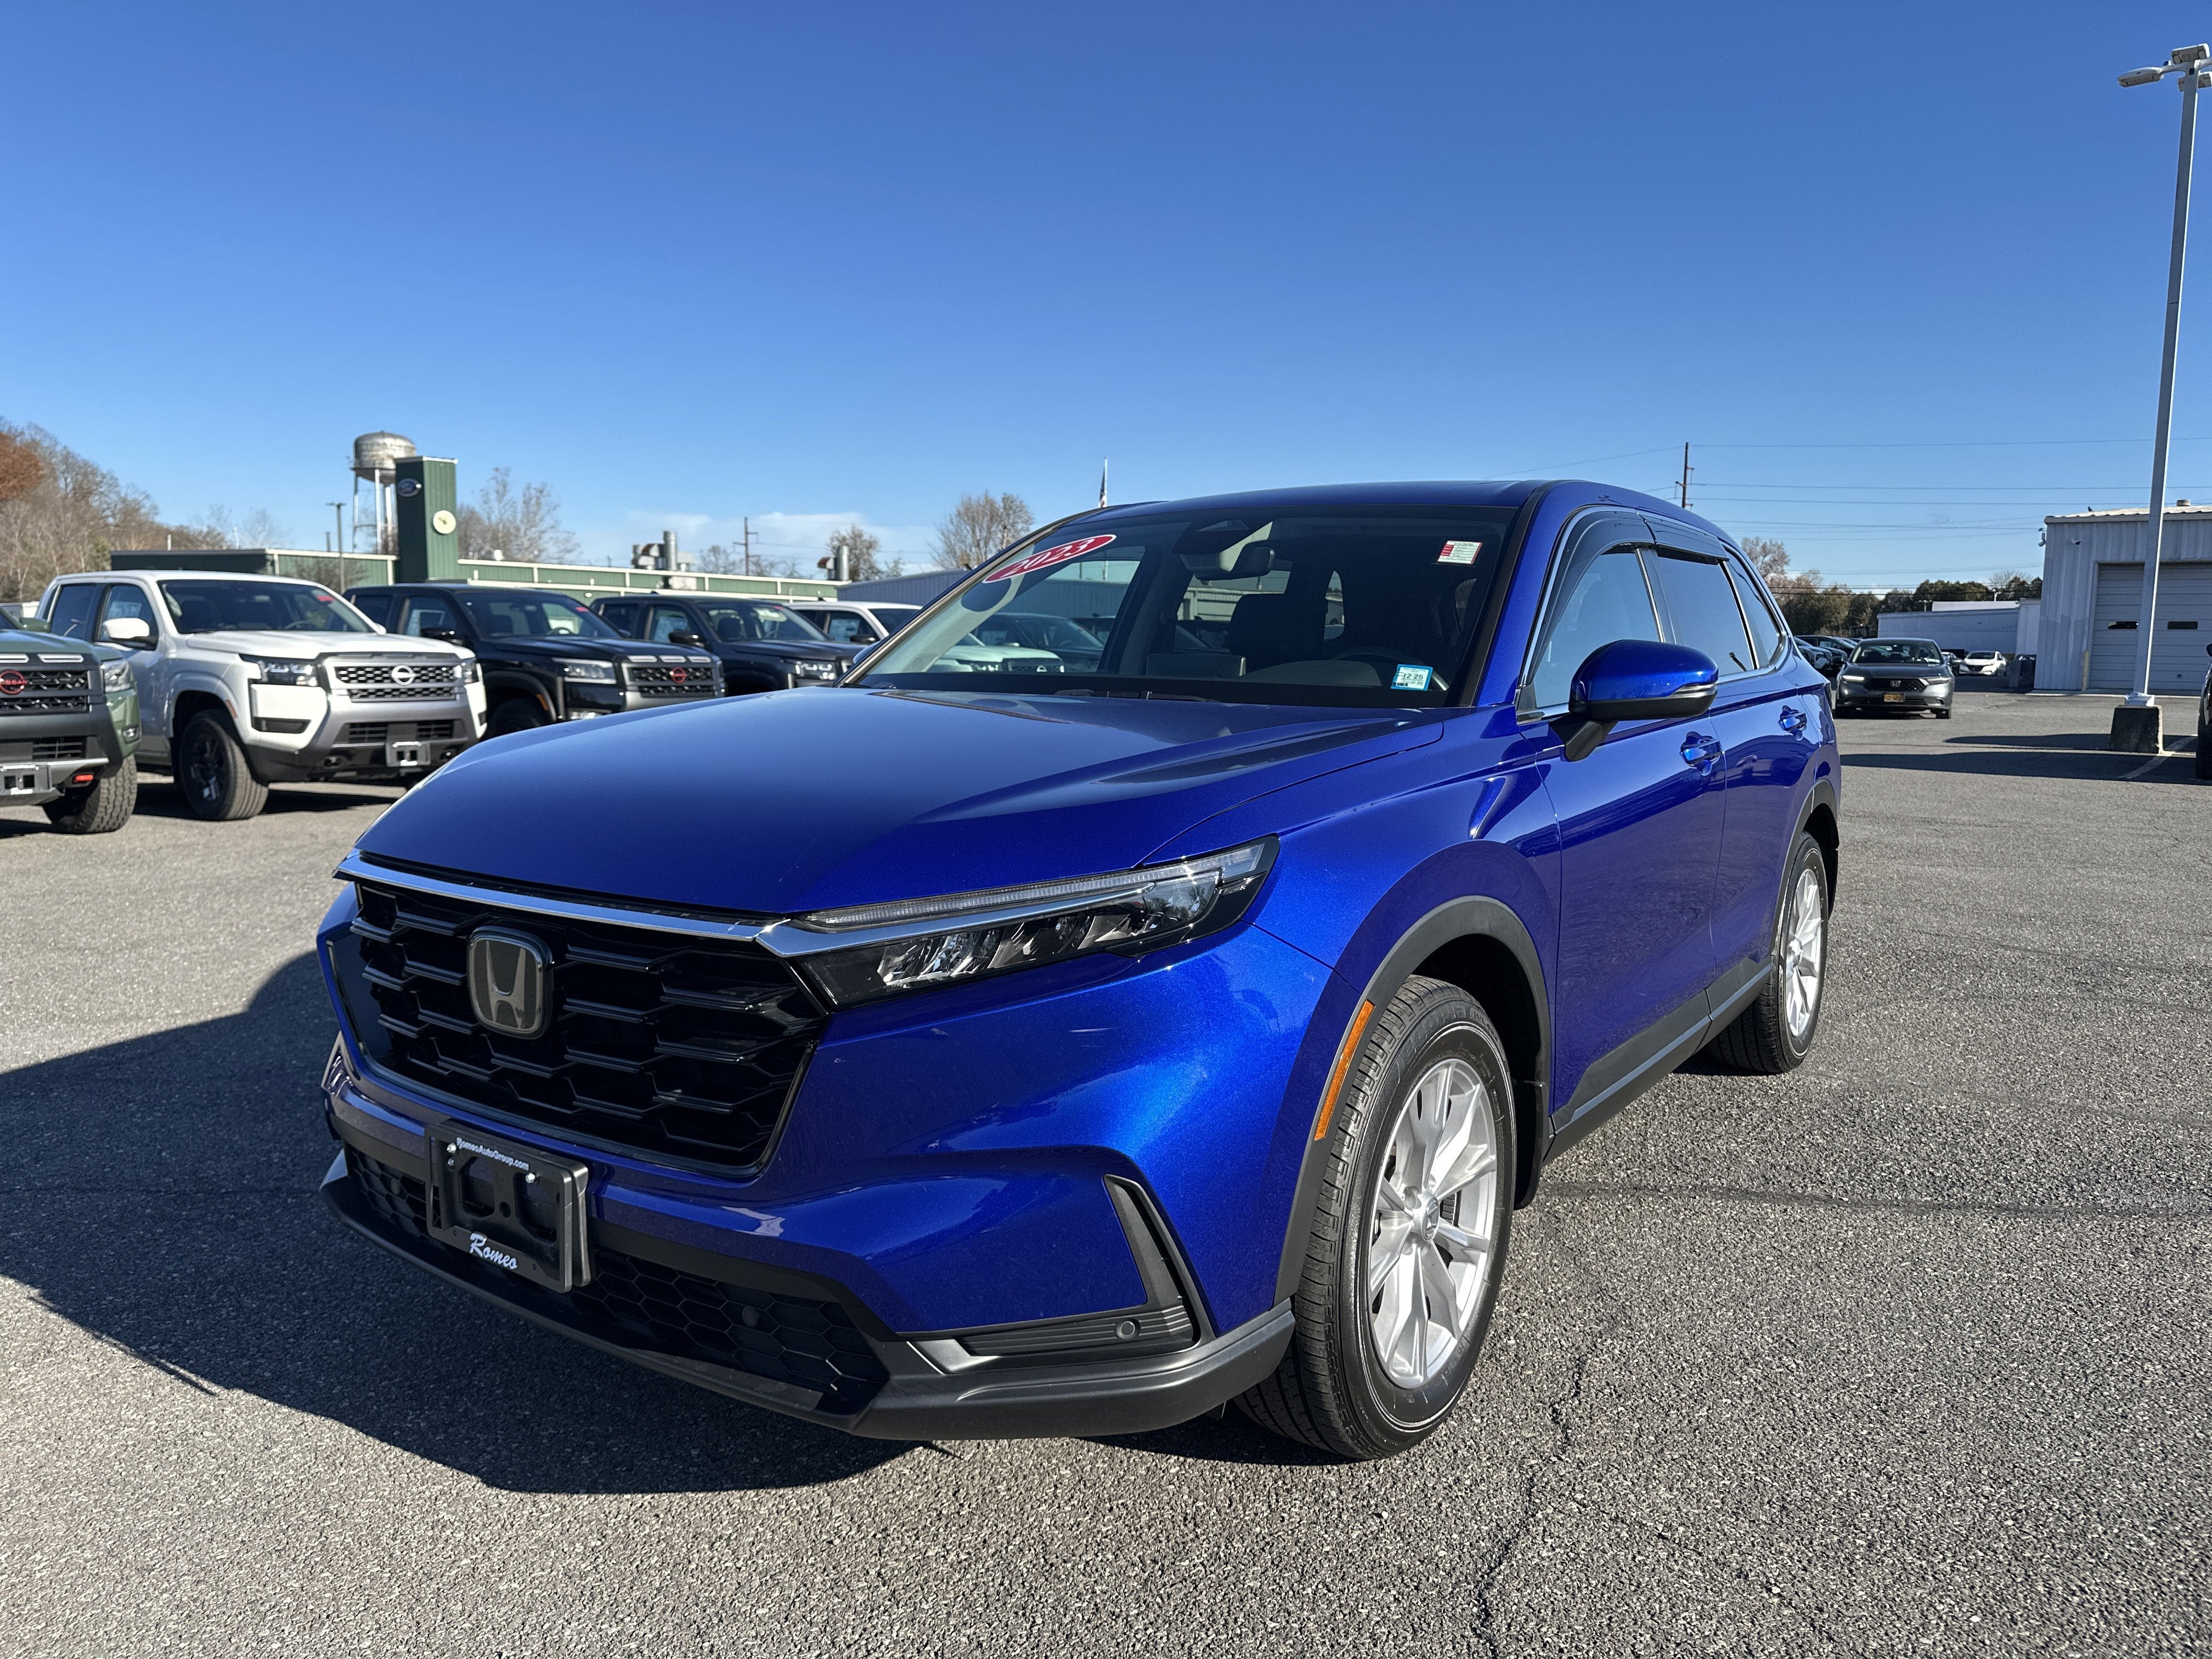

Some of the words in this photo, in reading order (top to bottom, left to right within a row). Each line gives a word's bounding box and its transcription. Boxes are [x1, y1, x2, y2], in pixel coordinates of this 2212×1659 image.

[999, 538, 1095, 578] 2023
[456, 1137, 529, 1170] RomeoAutoGroup.com
[469, 1232, 518, 1270] Romeo
